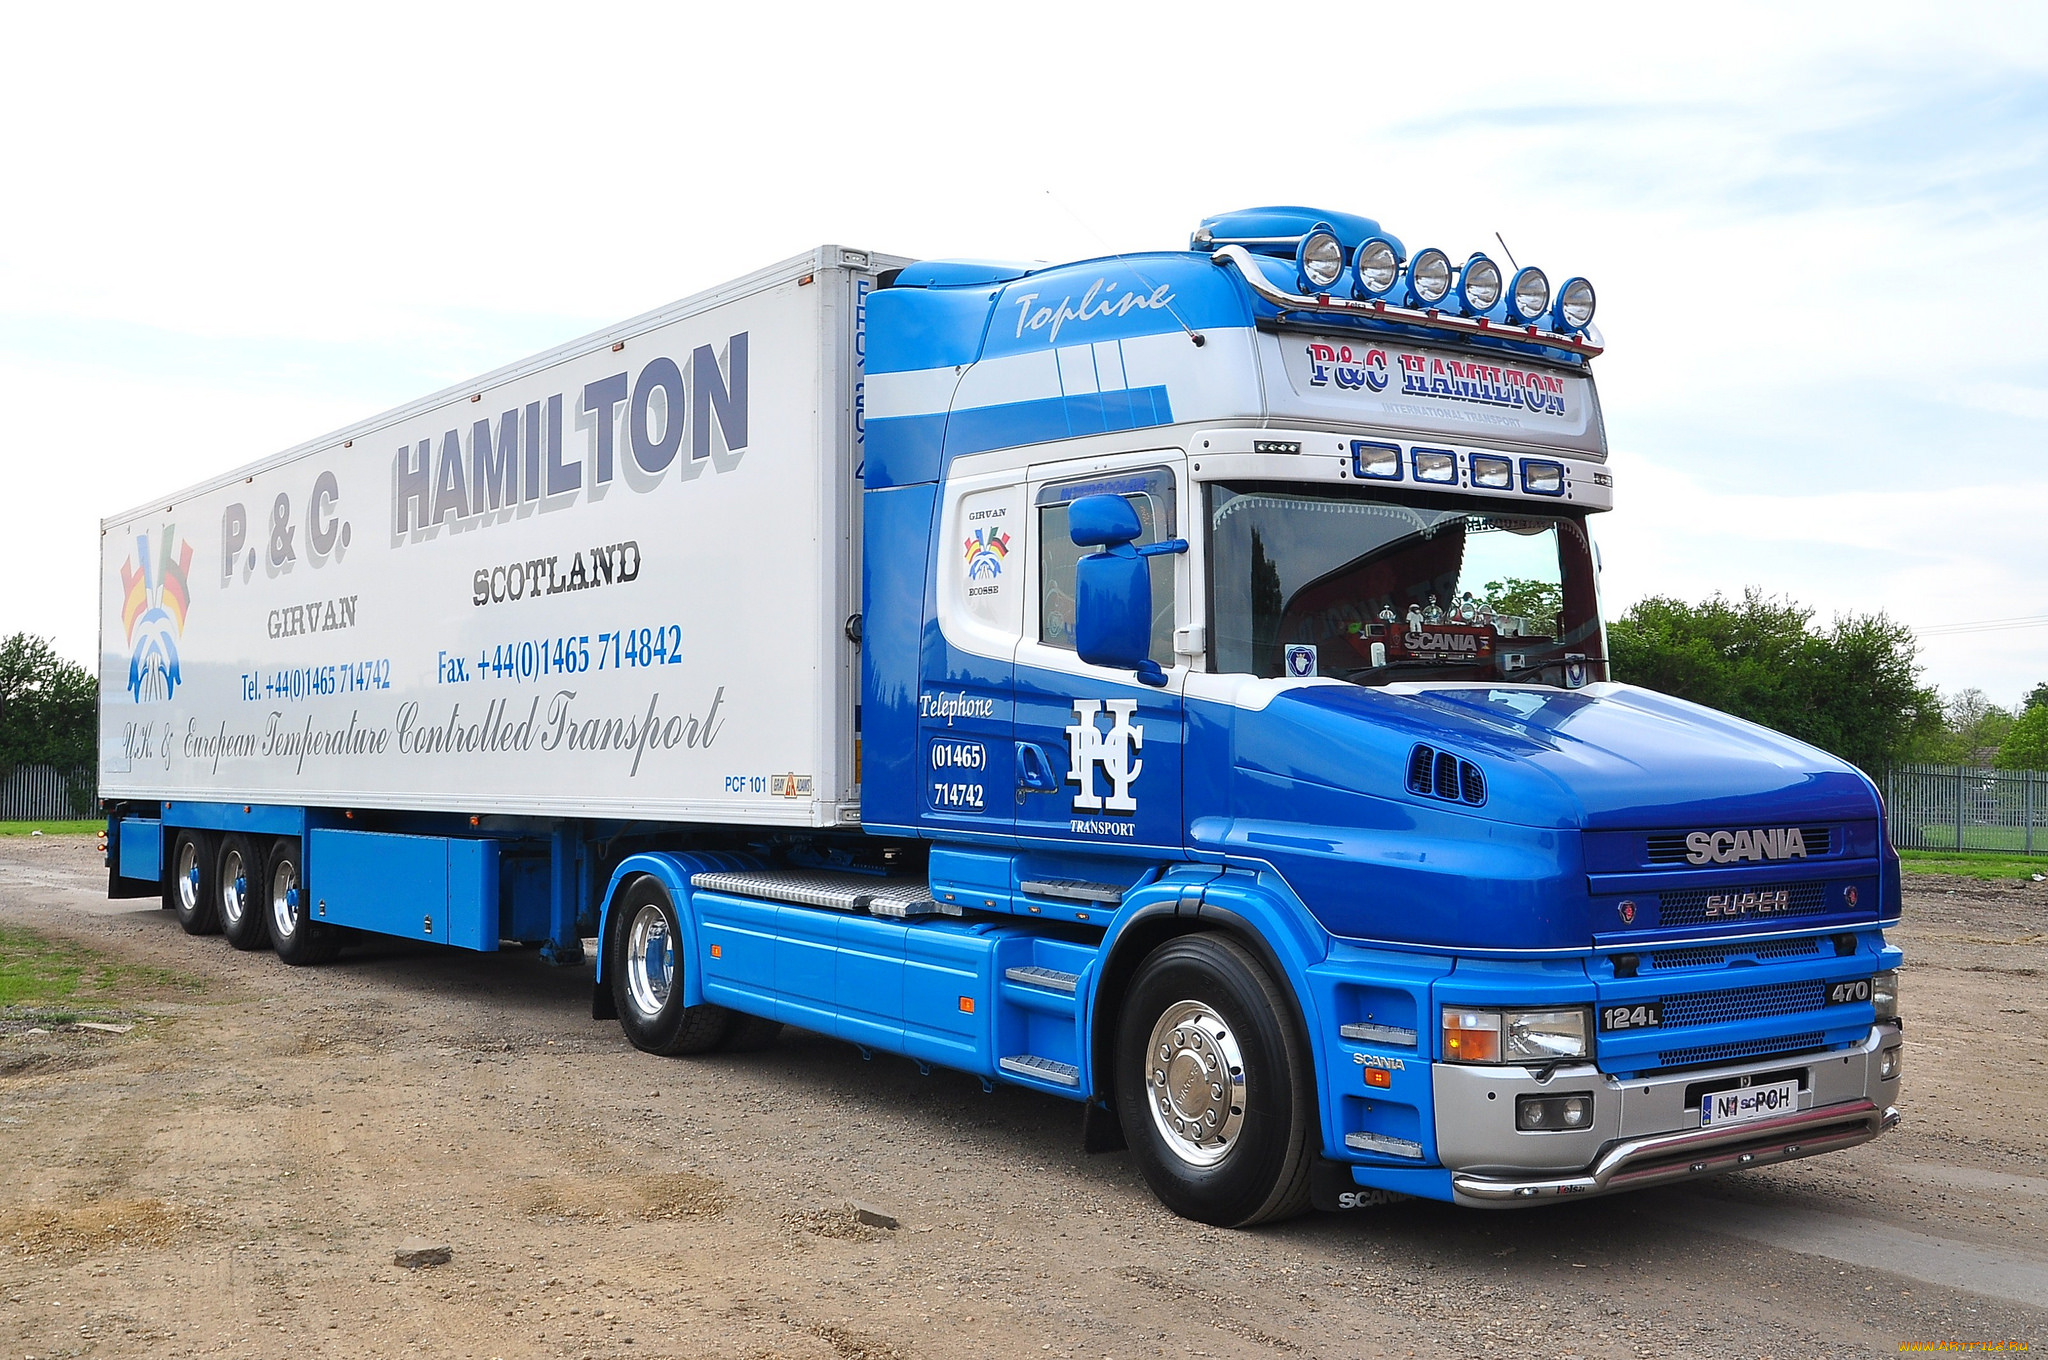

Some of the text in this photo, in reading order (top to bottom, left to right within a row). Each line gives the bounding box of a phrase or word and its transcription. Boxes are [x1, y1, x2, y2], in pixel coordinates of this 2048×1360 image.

[1015, 277, 1176, 343] Topline
[1307, 343, 1566, 416] P&C HAMILTON
[1382, 402, 1521, 427] INTERNATIONAL TRANSPORT
[222, 330, 749, 582] P. & C. HAMILTON
[968, 508, 1007, 521] GIRVAN
[473, 540, 642, 607] SCOTLAND
[968, 586, 999, 597] ECOSSE
[267, 595, 358, 639] GIRVAN
[1404, 632, 1477, 652] SCANIA
[438, 624, 682, 689] Fax. +44(0)1465 714842
[241, 658, 391, 702] Tel. +44(0)1465 714742
[920, 691, 994, 727] Telephone
[122, 686, 726, 777] U.K. & European Temperature Controlled Transport
[931, 744, 987, 772] (01465)
[725, 776, 766, 793] PCF 101
[934, 784, 984, 808] 714742
[1070, 819, 1136, 837] TRANSPORT
[1685, 827, 1808, 865] SCANIA
[1705, 890, 1789, 916] SUPER
[1831, 980, 1869, 1003] 470
[1352, 1052, 1406, 1071] SCANIA
[1338, 1190, 1400, 1208] SCAN
